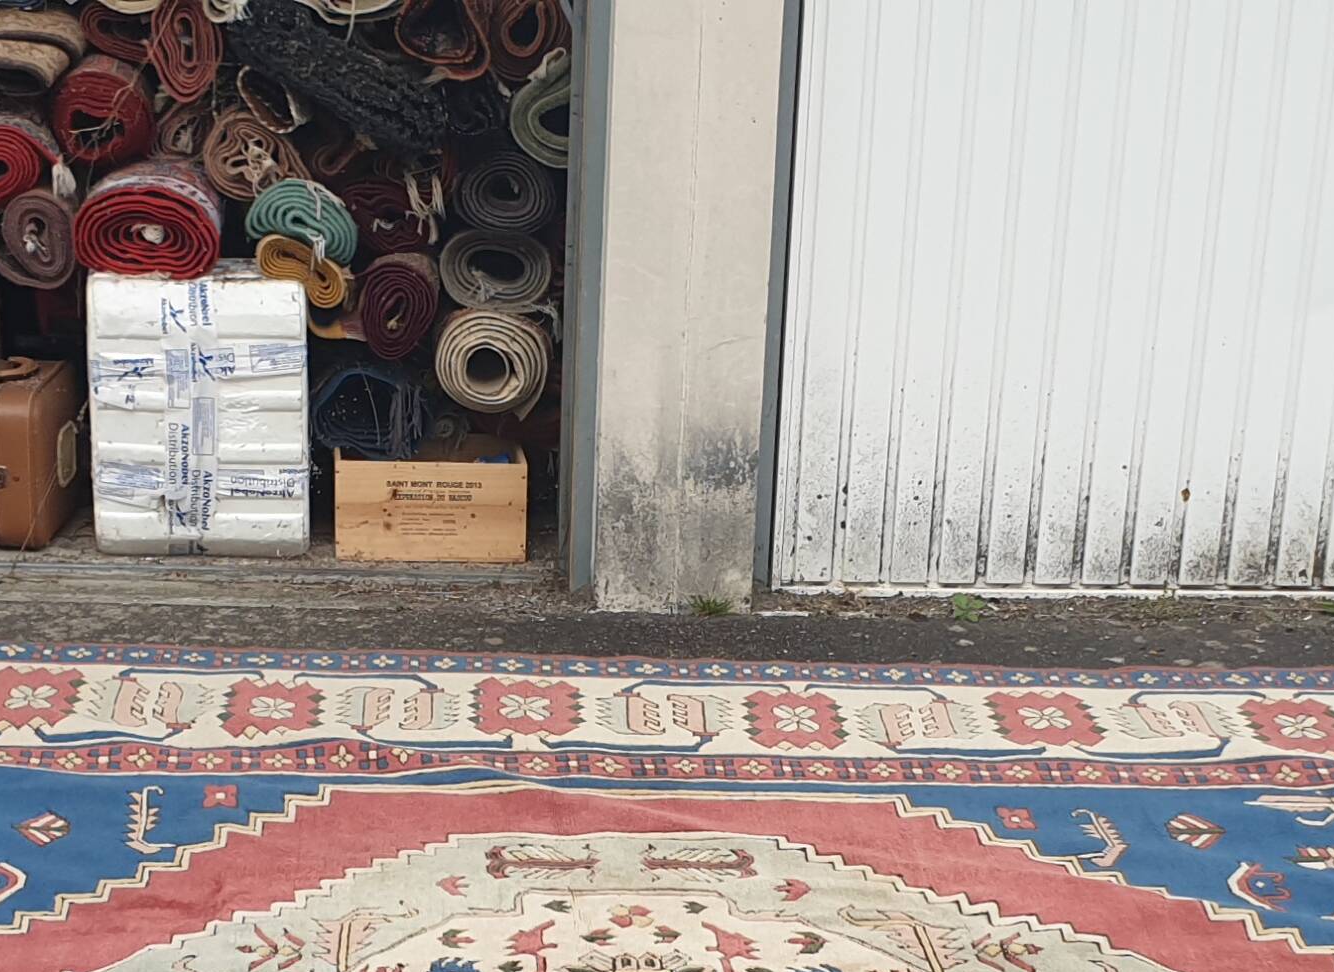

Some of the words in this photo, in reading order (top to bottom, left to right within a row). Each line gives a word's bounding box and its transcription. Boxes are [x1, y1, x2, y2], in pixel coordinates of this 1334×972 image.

[168, 422, 178, 485] Distribution
[180, 424, 190, 485] AkzoNobel
[202, 470, 213, 531] AkzoNobel
[436, 481, 464, 489] ROUGE
